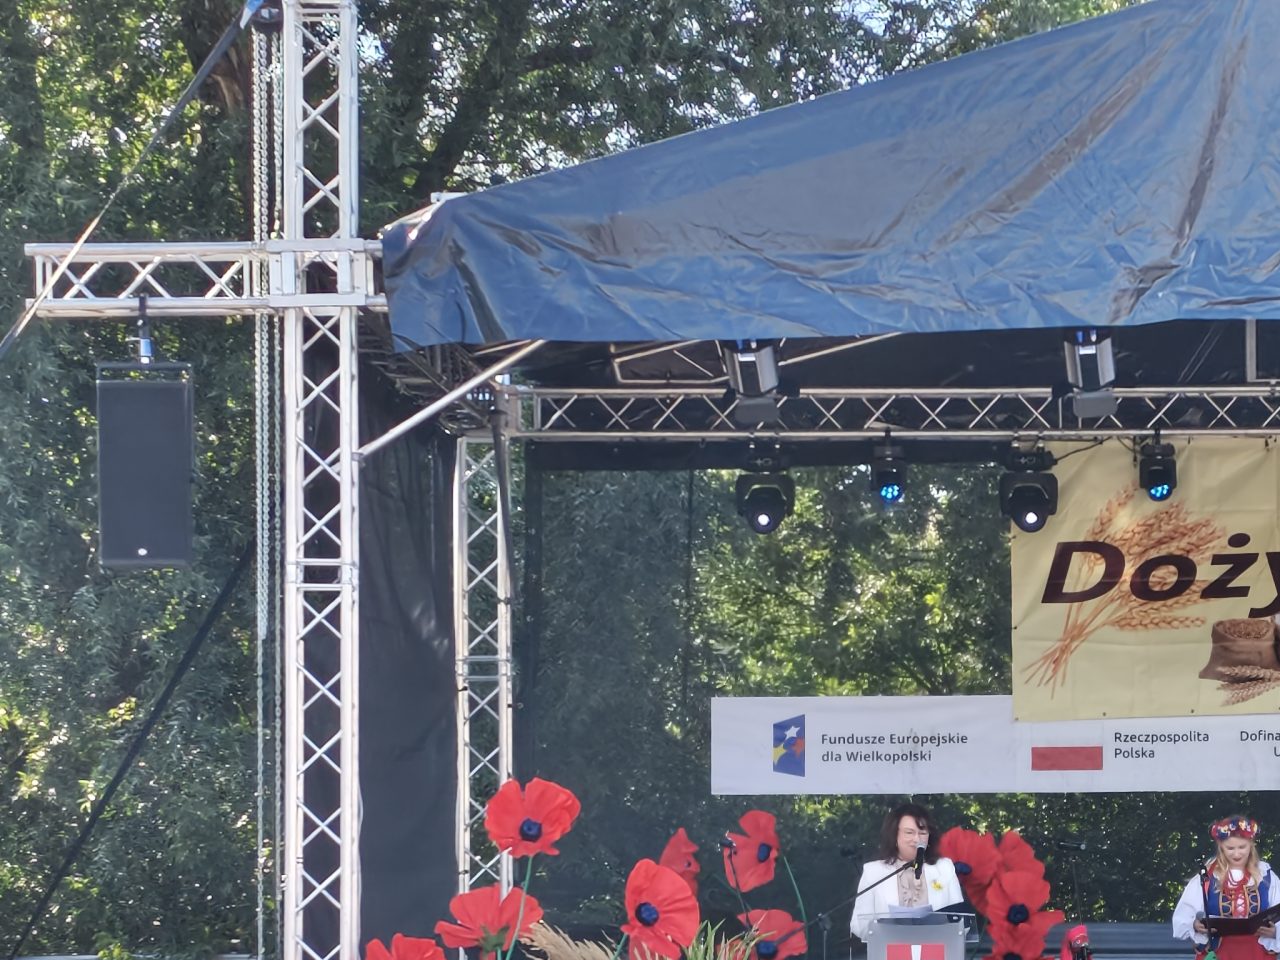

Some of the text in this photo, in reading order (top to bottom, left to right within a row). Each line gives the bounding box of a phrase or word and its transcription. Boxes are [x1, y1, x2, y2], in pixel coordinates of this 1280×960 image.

[821, 732, 969, 747] Fundusze Europejskie
[1114, 730, 1210, 746] Rzeczpospolita
[821, 750, 932, 765] dla Wielkopolski
[1114, 747, 1156, 760] Polska
